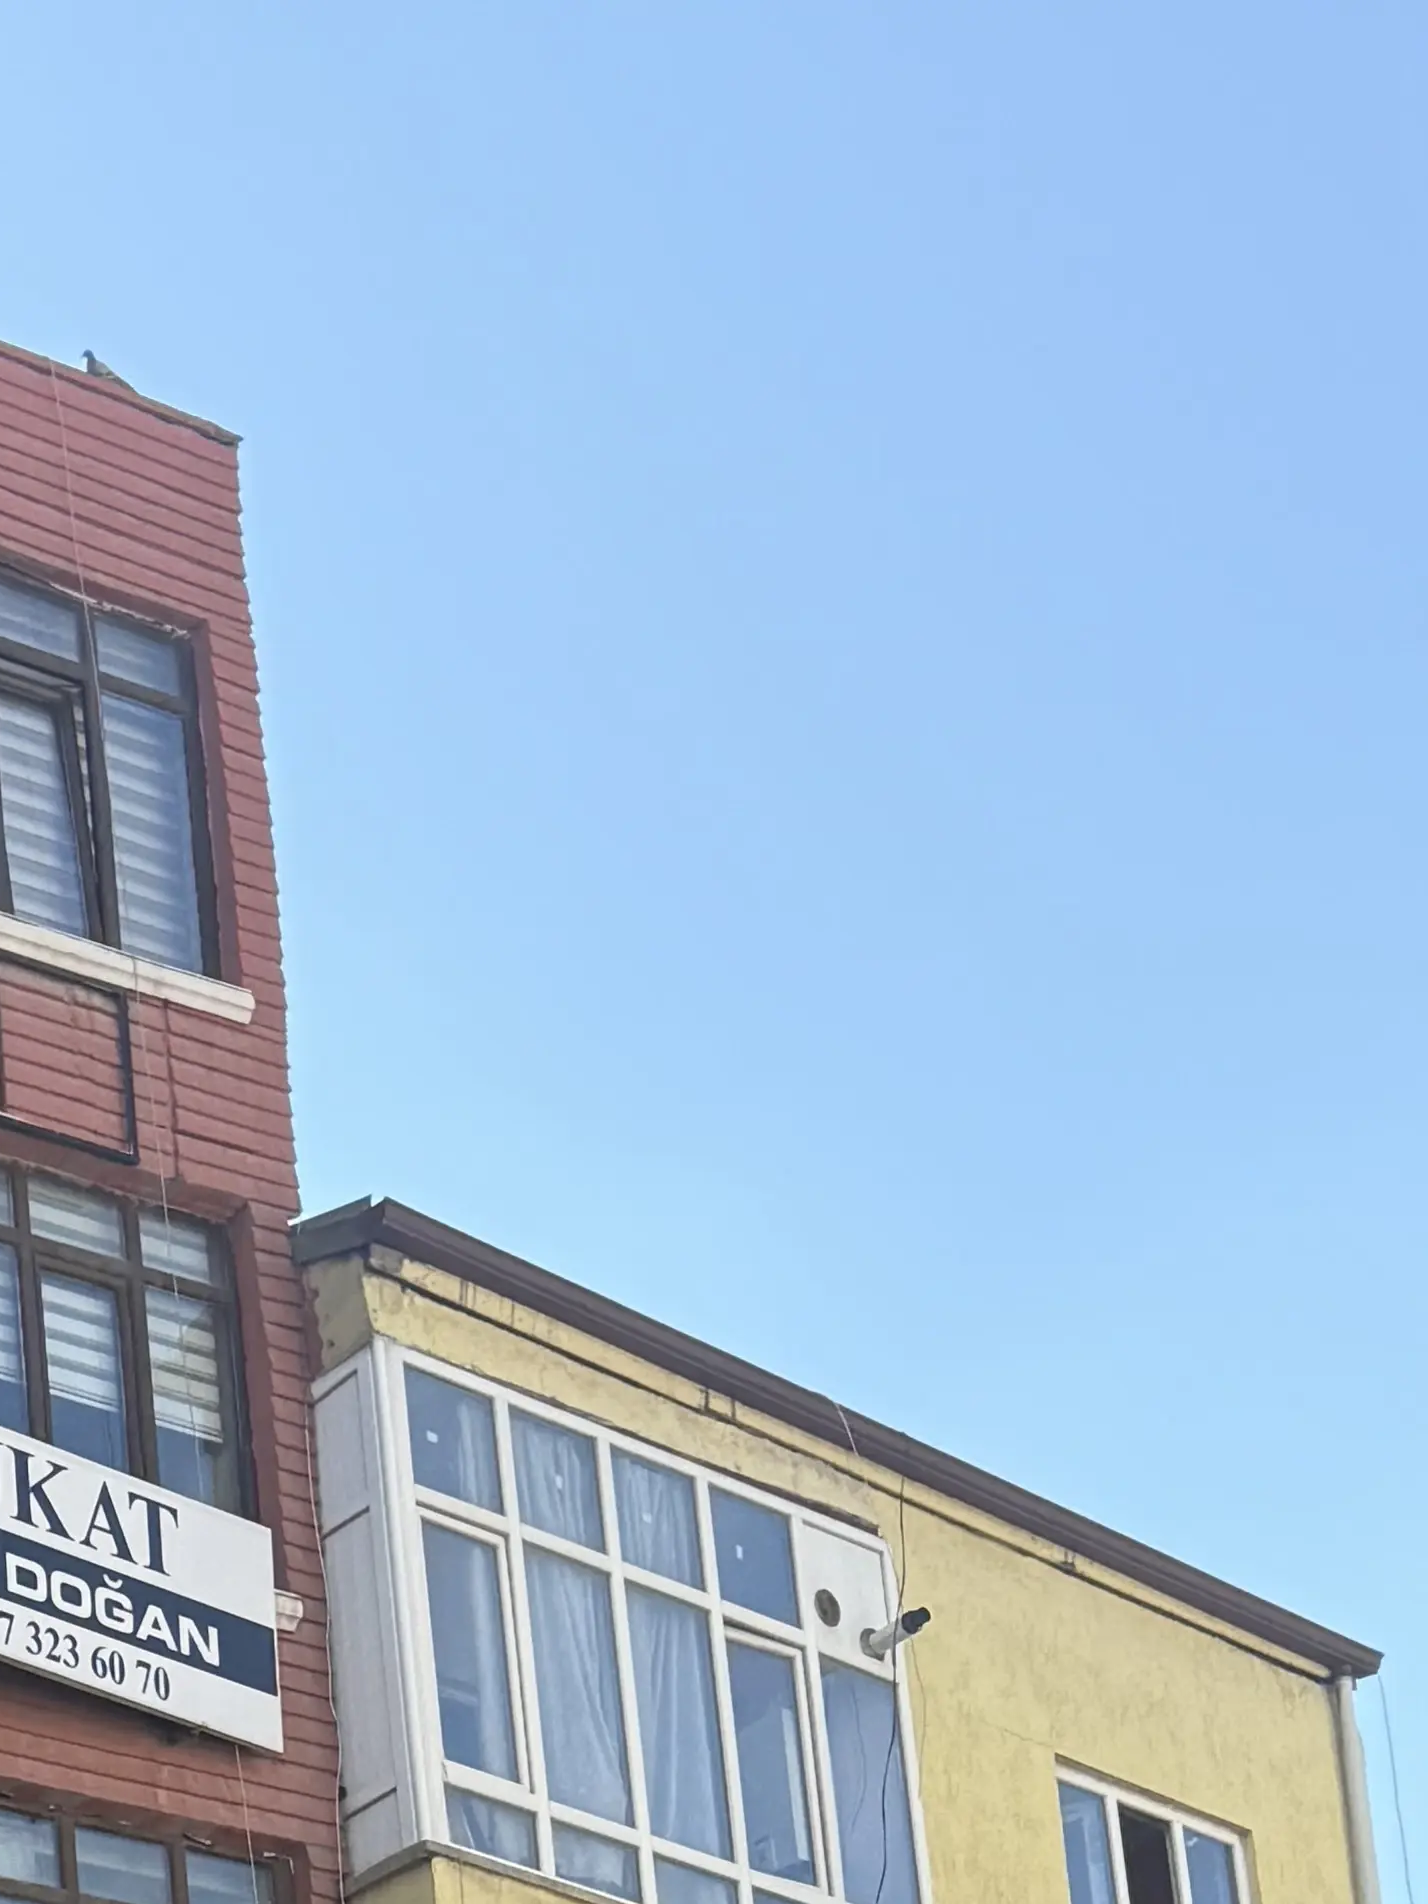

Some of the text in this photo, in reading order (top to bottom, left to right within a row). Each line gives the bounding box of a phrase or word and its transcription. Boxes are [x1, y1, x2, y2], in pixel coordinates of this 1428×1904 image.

[5, 1552, 220, 1668] DOĞAN
[25, 1621, 80, 1668] 323
[90, 1645, 126, 1686] 60
[136, 1658, 171, 1702] 70
